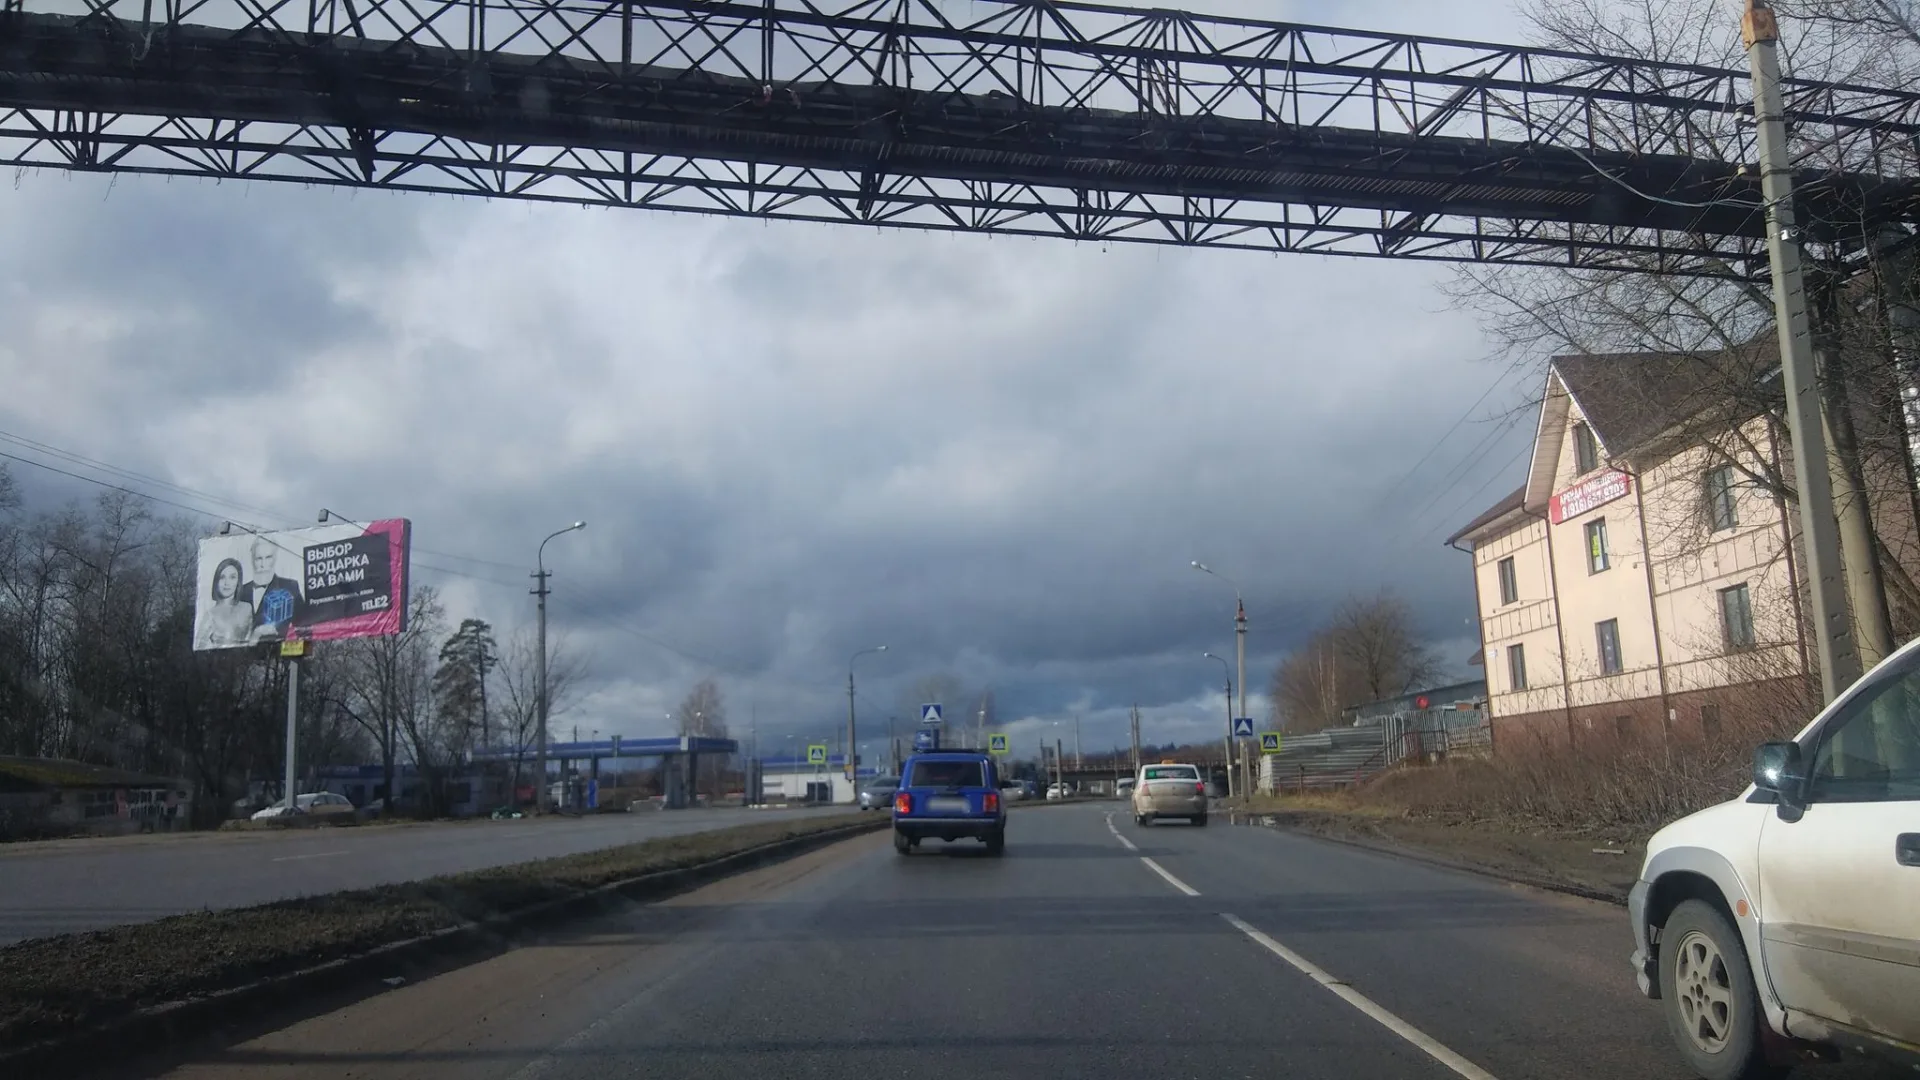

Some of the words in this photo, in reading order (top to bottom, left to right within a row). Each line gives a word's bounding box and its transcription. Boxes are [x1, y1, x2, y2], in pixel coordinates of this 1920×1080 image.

[307, 542, 353, 562] ВЫБОР
[307, 553, 370, 576] ПОДАРКА
[308, 576, 326, 590] ЗА
[328, 568, 365, 587] ВАМИ
[361, 594, 389, 611] TELE2
